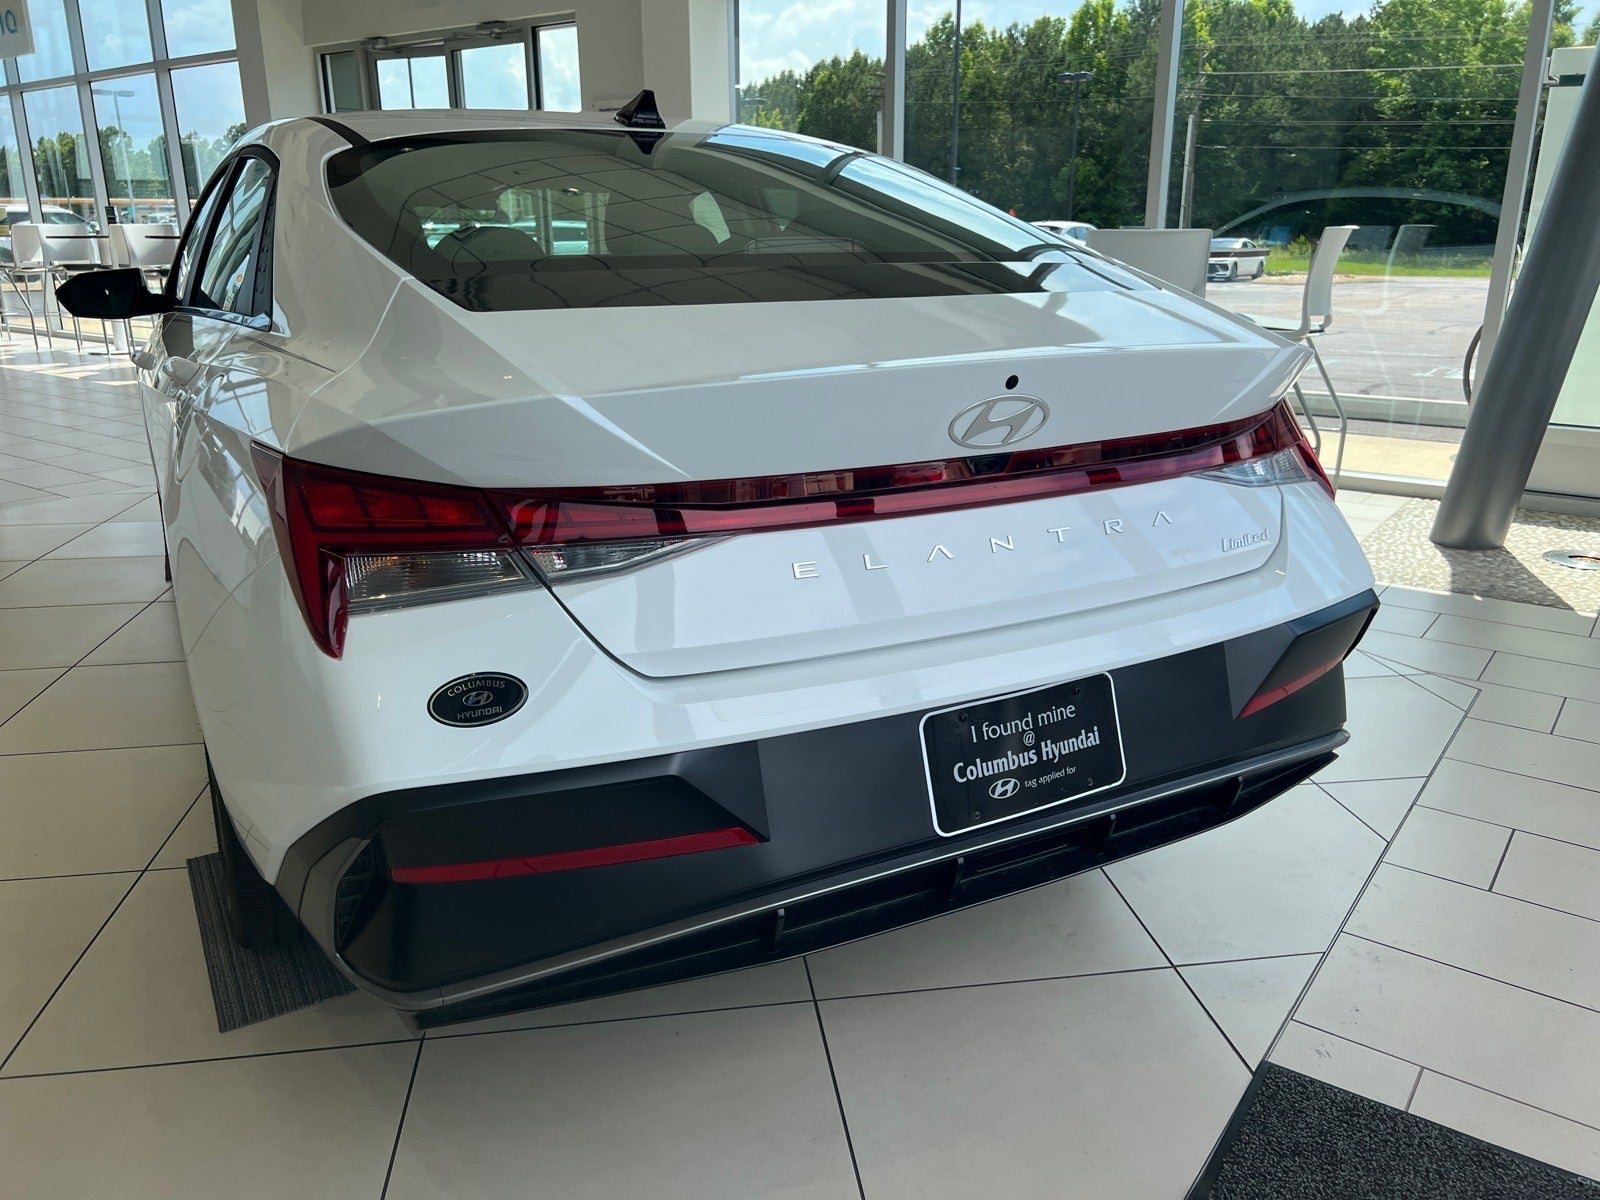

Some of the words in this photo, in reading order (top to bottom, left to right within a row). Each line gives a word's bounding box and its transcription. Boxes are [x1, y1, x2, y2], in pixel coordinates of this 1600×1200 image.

[792, 511, 1173, 579] ELANTRA
[1221, 528, 1269, 552] Limited
[447, 680, 506, 697] COLUMBUS
[456, 706, 503, 720] HYUNDAI
[970, 725, 978, 743] I
[982, 712, 1033, 740] found
[1038, 705, 1076, 727] mine
[1023, 730, 1035, 746] @
[953, 749, 1038, 783] Columbus
[1040, 725, 1100, 763] Hyundai
[1024, 779, 1038, 788] tag
[1038, 769, 1065, 785] applied
[1066, 766, 1077, 776] for
